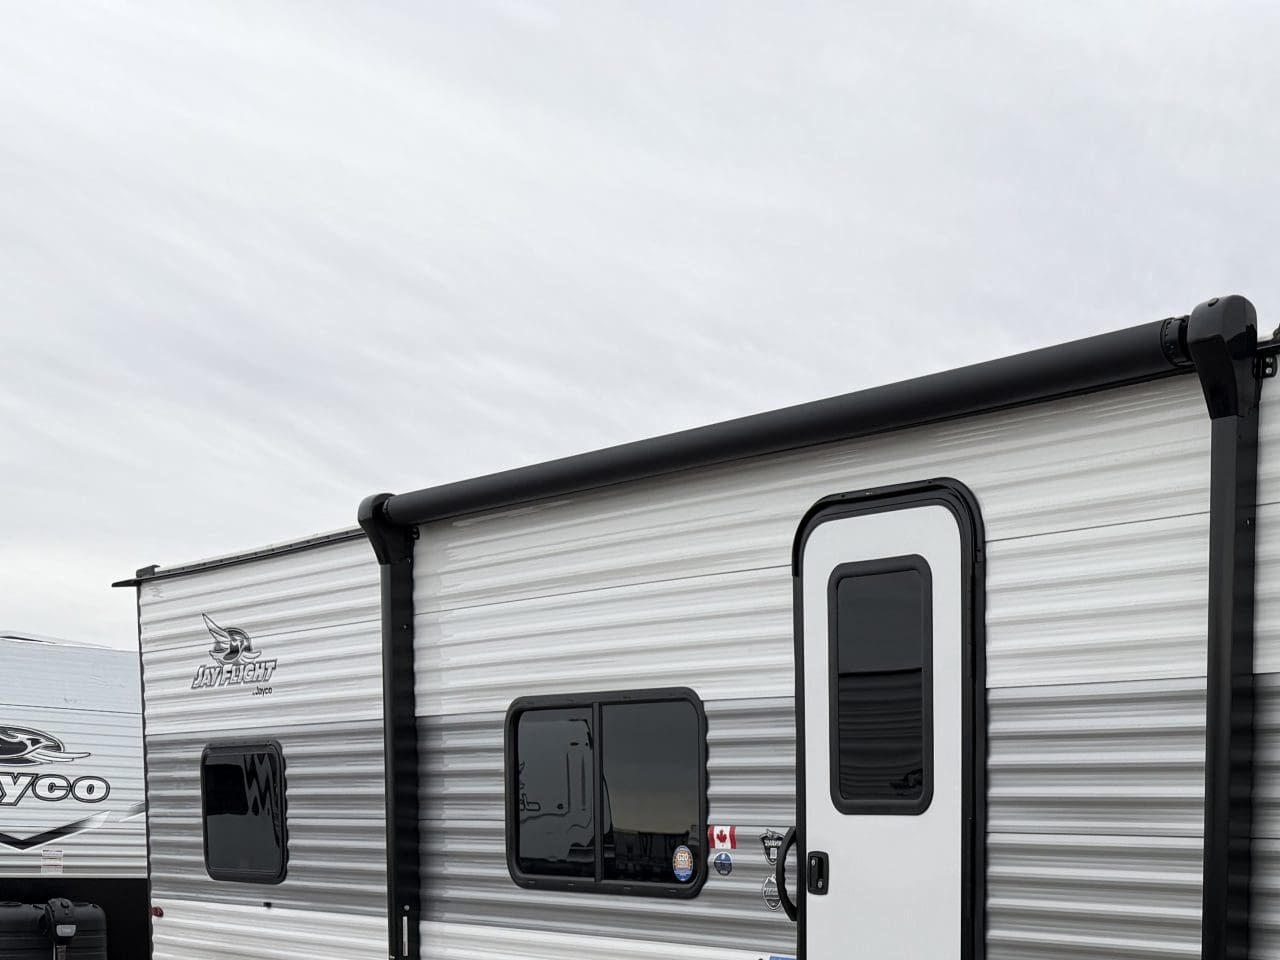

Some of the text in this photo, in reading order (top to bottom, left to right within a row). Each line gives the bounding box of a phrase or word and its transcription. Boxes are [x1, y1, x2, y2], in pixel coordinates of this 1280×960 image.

[191, 659, 278, 690] JAY FLIGHT
[255, 685, 273, 697] Jayco
[0, 772, 111, 806] yco
